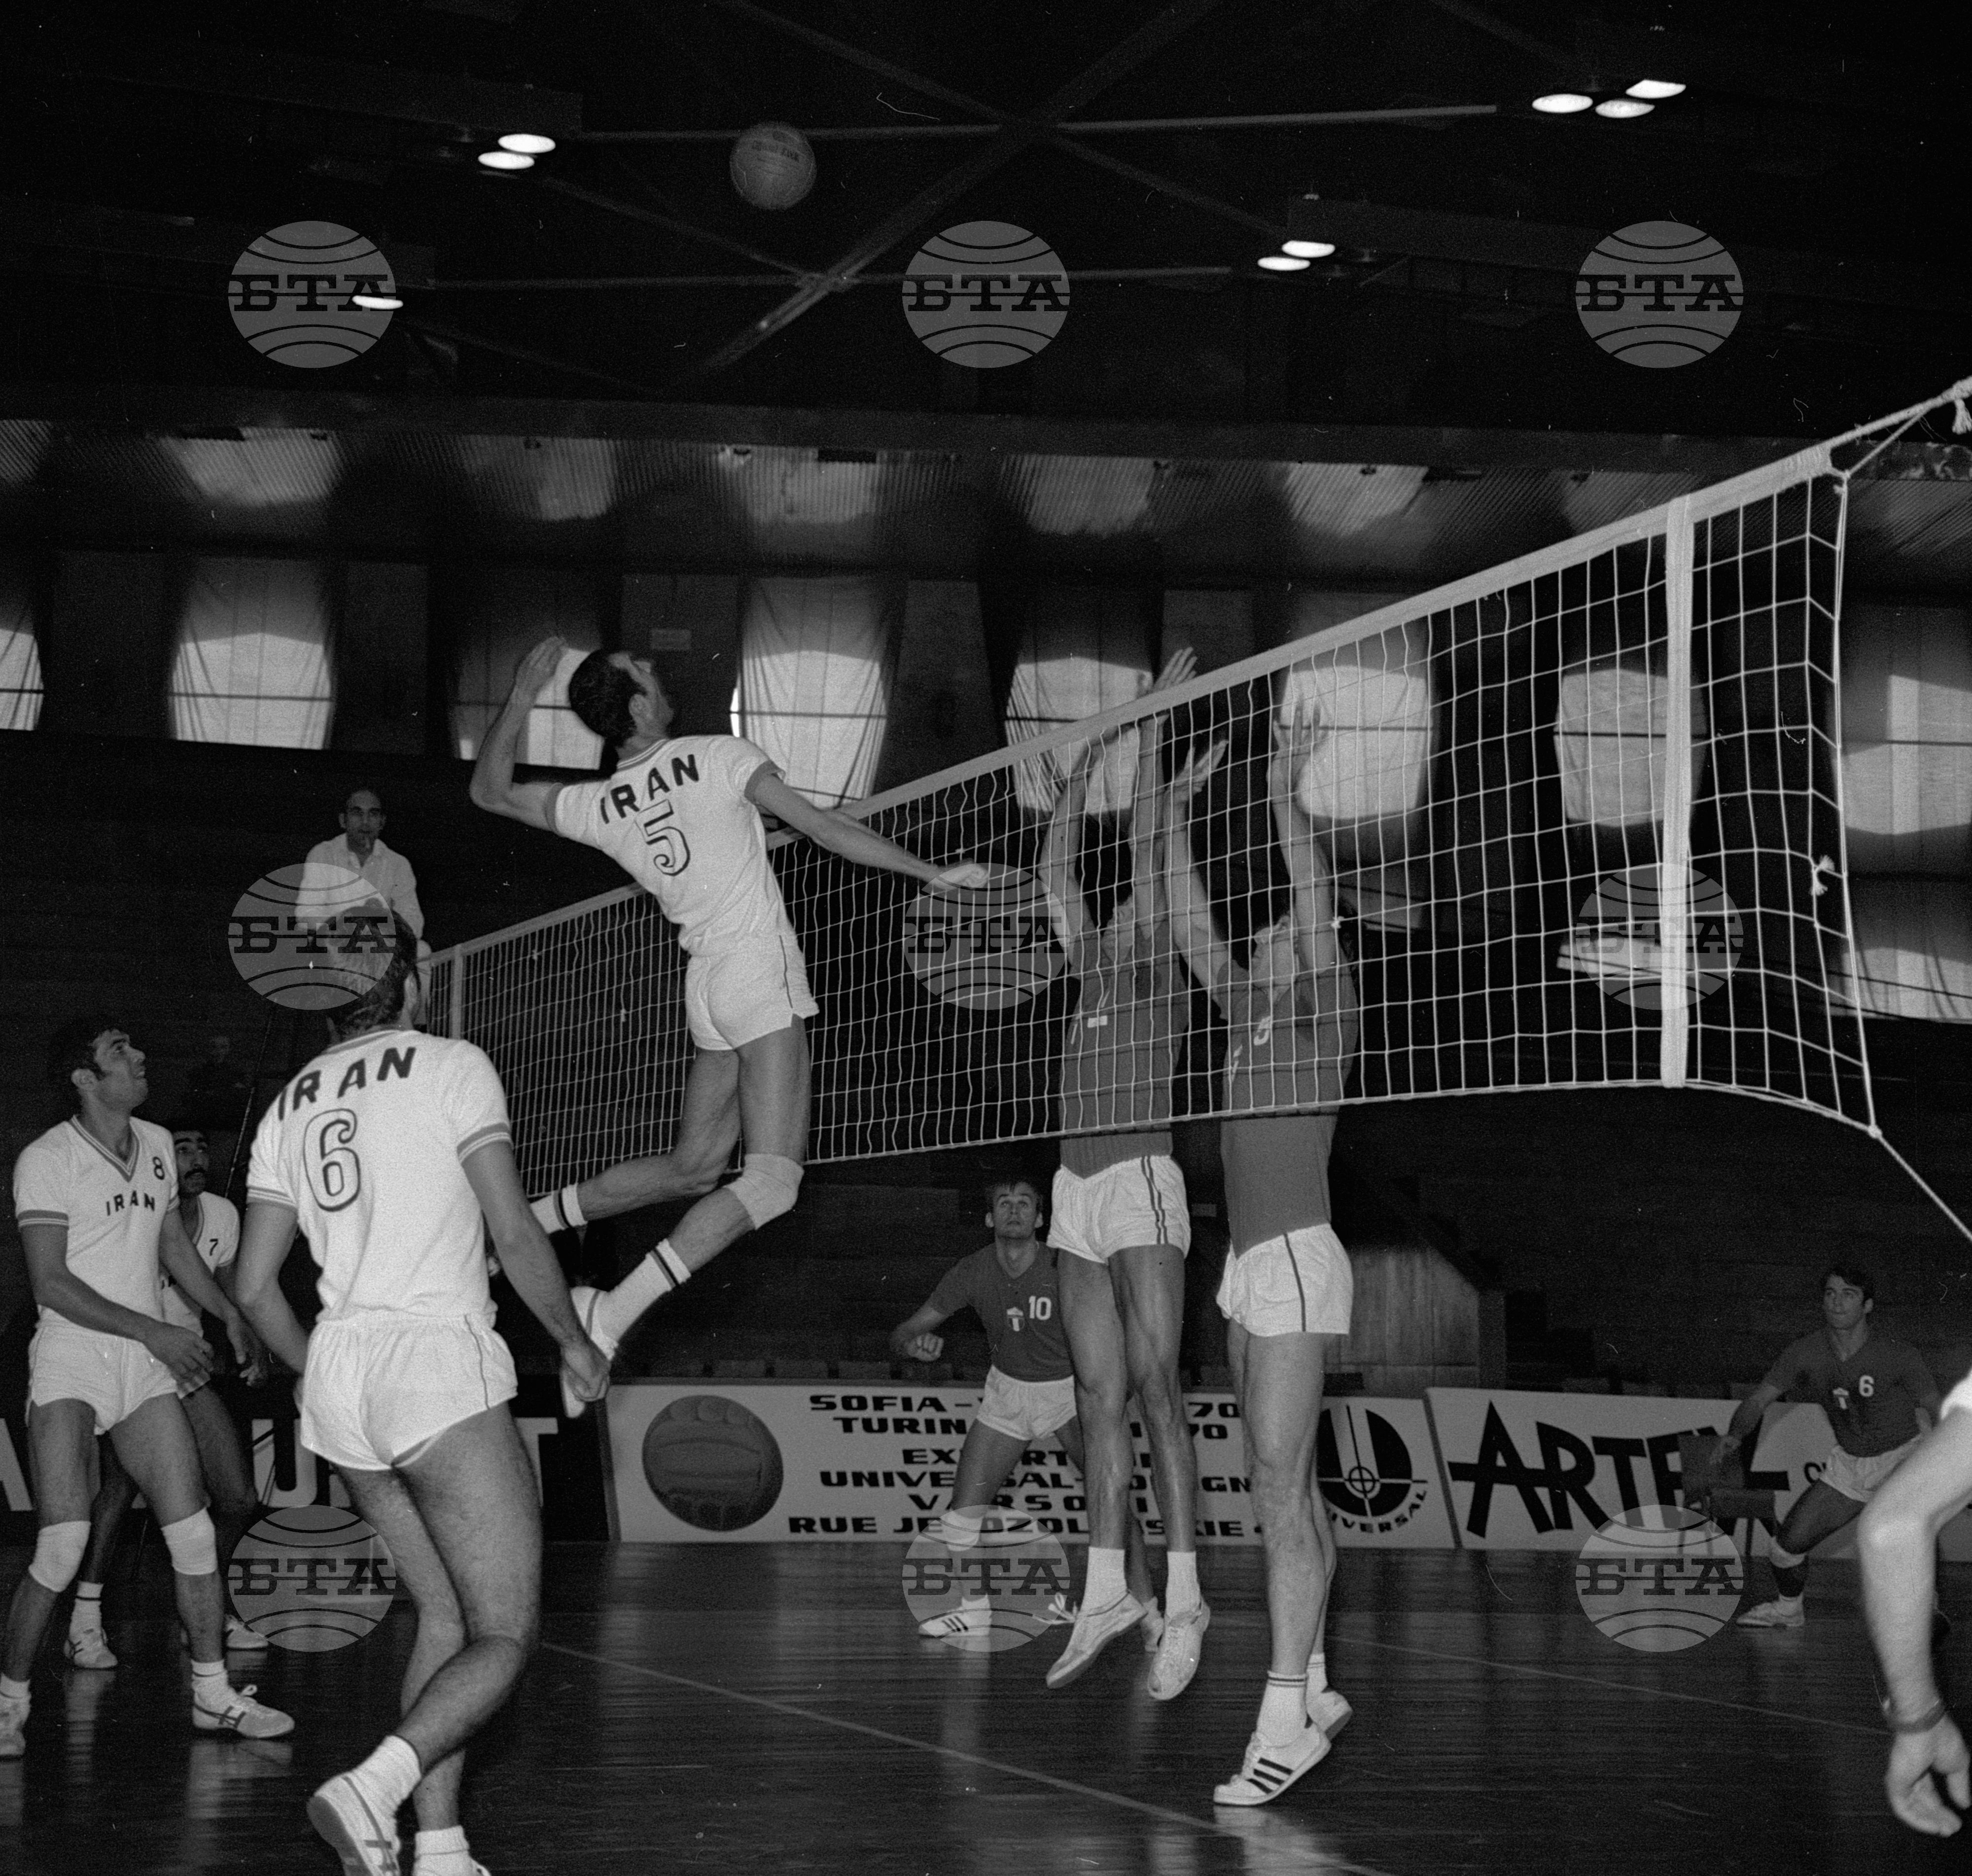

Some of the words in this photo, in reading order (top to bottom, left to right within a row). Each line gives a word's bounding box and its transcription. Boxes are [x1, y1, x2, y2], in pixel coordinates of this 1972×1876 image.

[600, 754, 699, 824] IRAN
[634, 799, 690, 876] 5
[277, 1047, 416, 1121] IRAN
[152, 1156, 165, 1180] 8
[302, 1108, 360, 1211] 6
[106, 1190, 155, 1216] IRAN
[210, 1238, 218, 1256] 7
[1028, 1295, 1052, 1321] 10
[1858, 1375, 1874, 1397] 6
[833, 1417, 967, 1434] TURIN
[903, 1449, 1068, 1466] EXRT
[820, 1471, 1074, 1488] UNIVESAL
[789, 1517, 878, 1533] RUE
